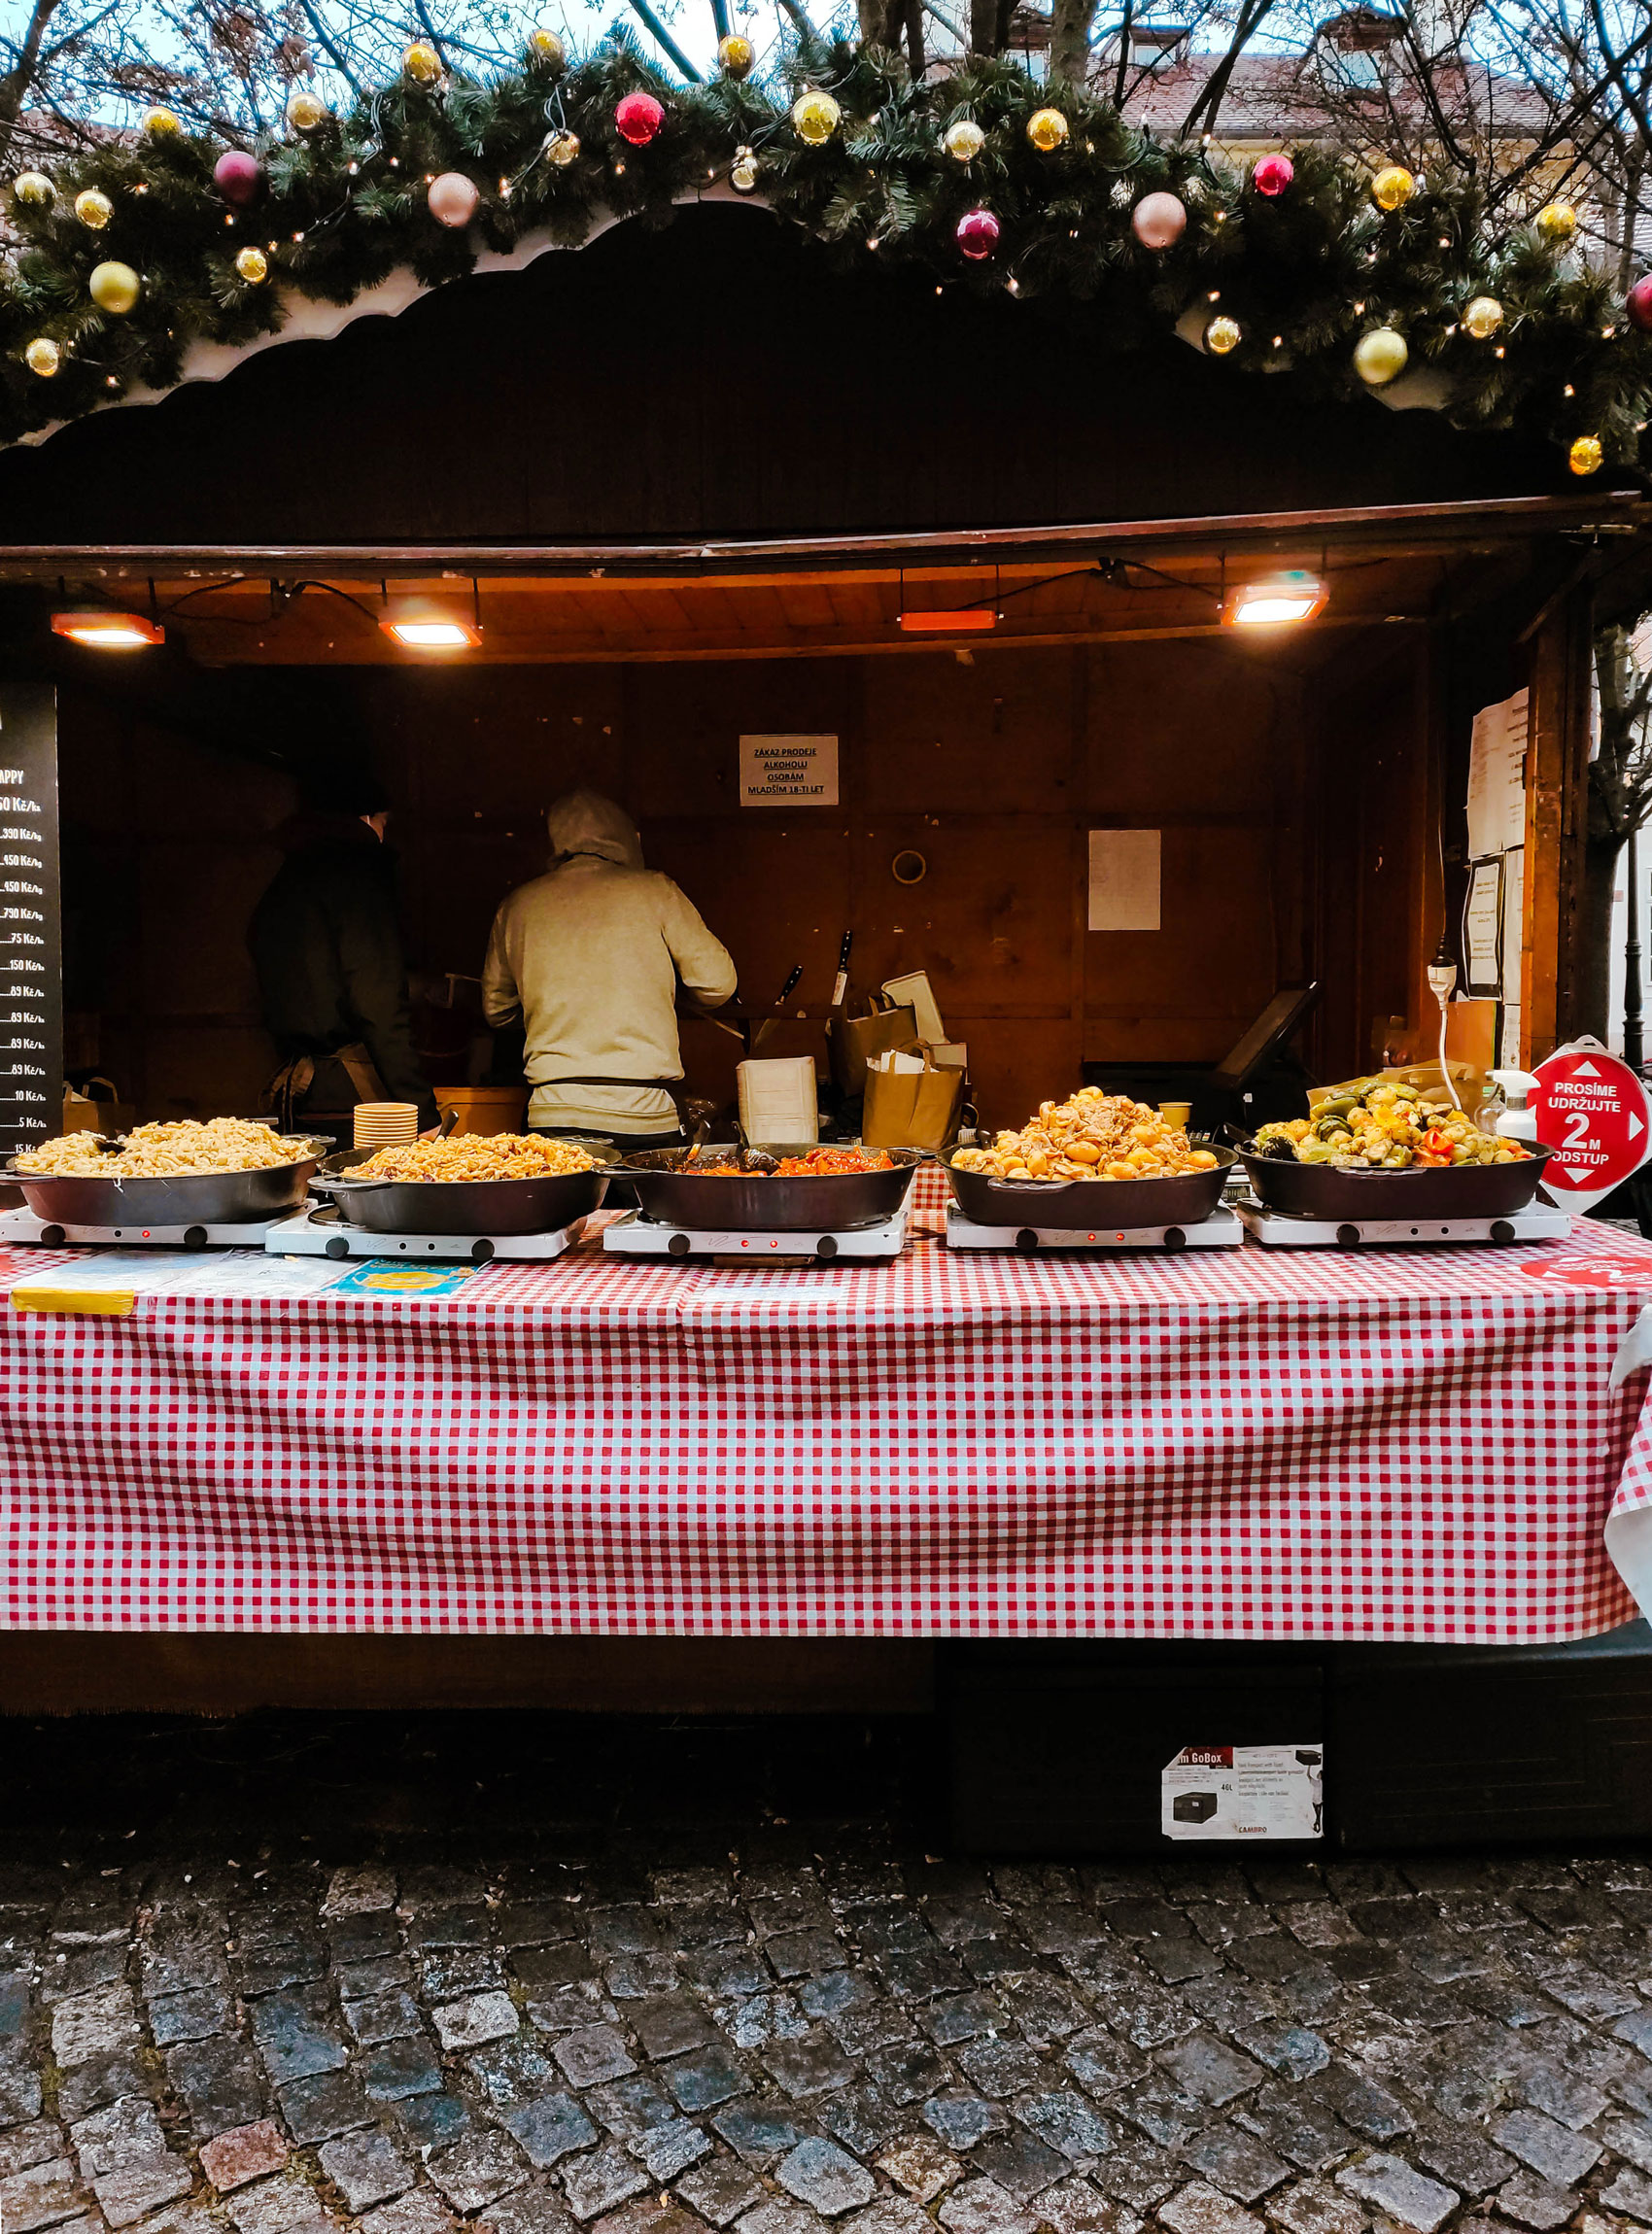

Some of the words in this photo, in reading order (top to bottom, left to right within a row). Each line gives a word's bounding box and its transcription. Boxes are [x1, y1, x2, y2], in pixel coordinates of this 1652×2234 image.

[754, 746, 779, 756] ZÁKAZ
[781, 747, 816, 756] PRODEJE
[747, 784, 787, 793] MLADŠÍM
[1555, 1082, 1617, 1097] PROSÍME
[1548, 1096, 1621, 1113] UDRŽUJTE
[1561, 1113, 1591, 1150] 2
[1589, 1139, 1600, 1151] M
[1552, 1151, 1609, 1165] ODSTUP
[1191, 1752, 1222, 1764] GoBox
